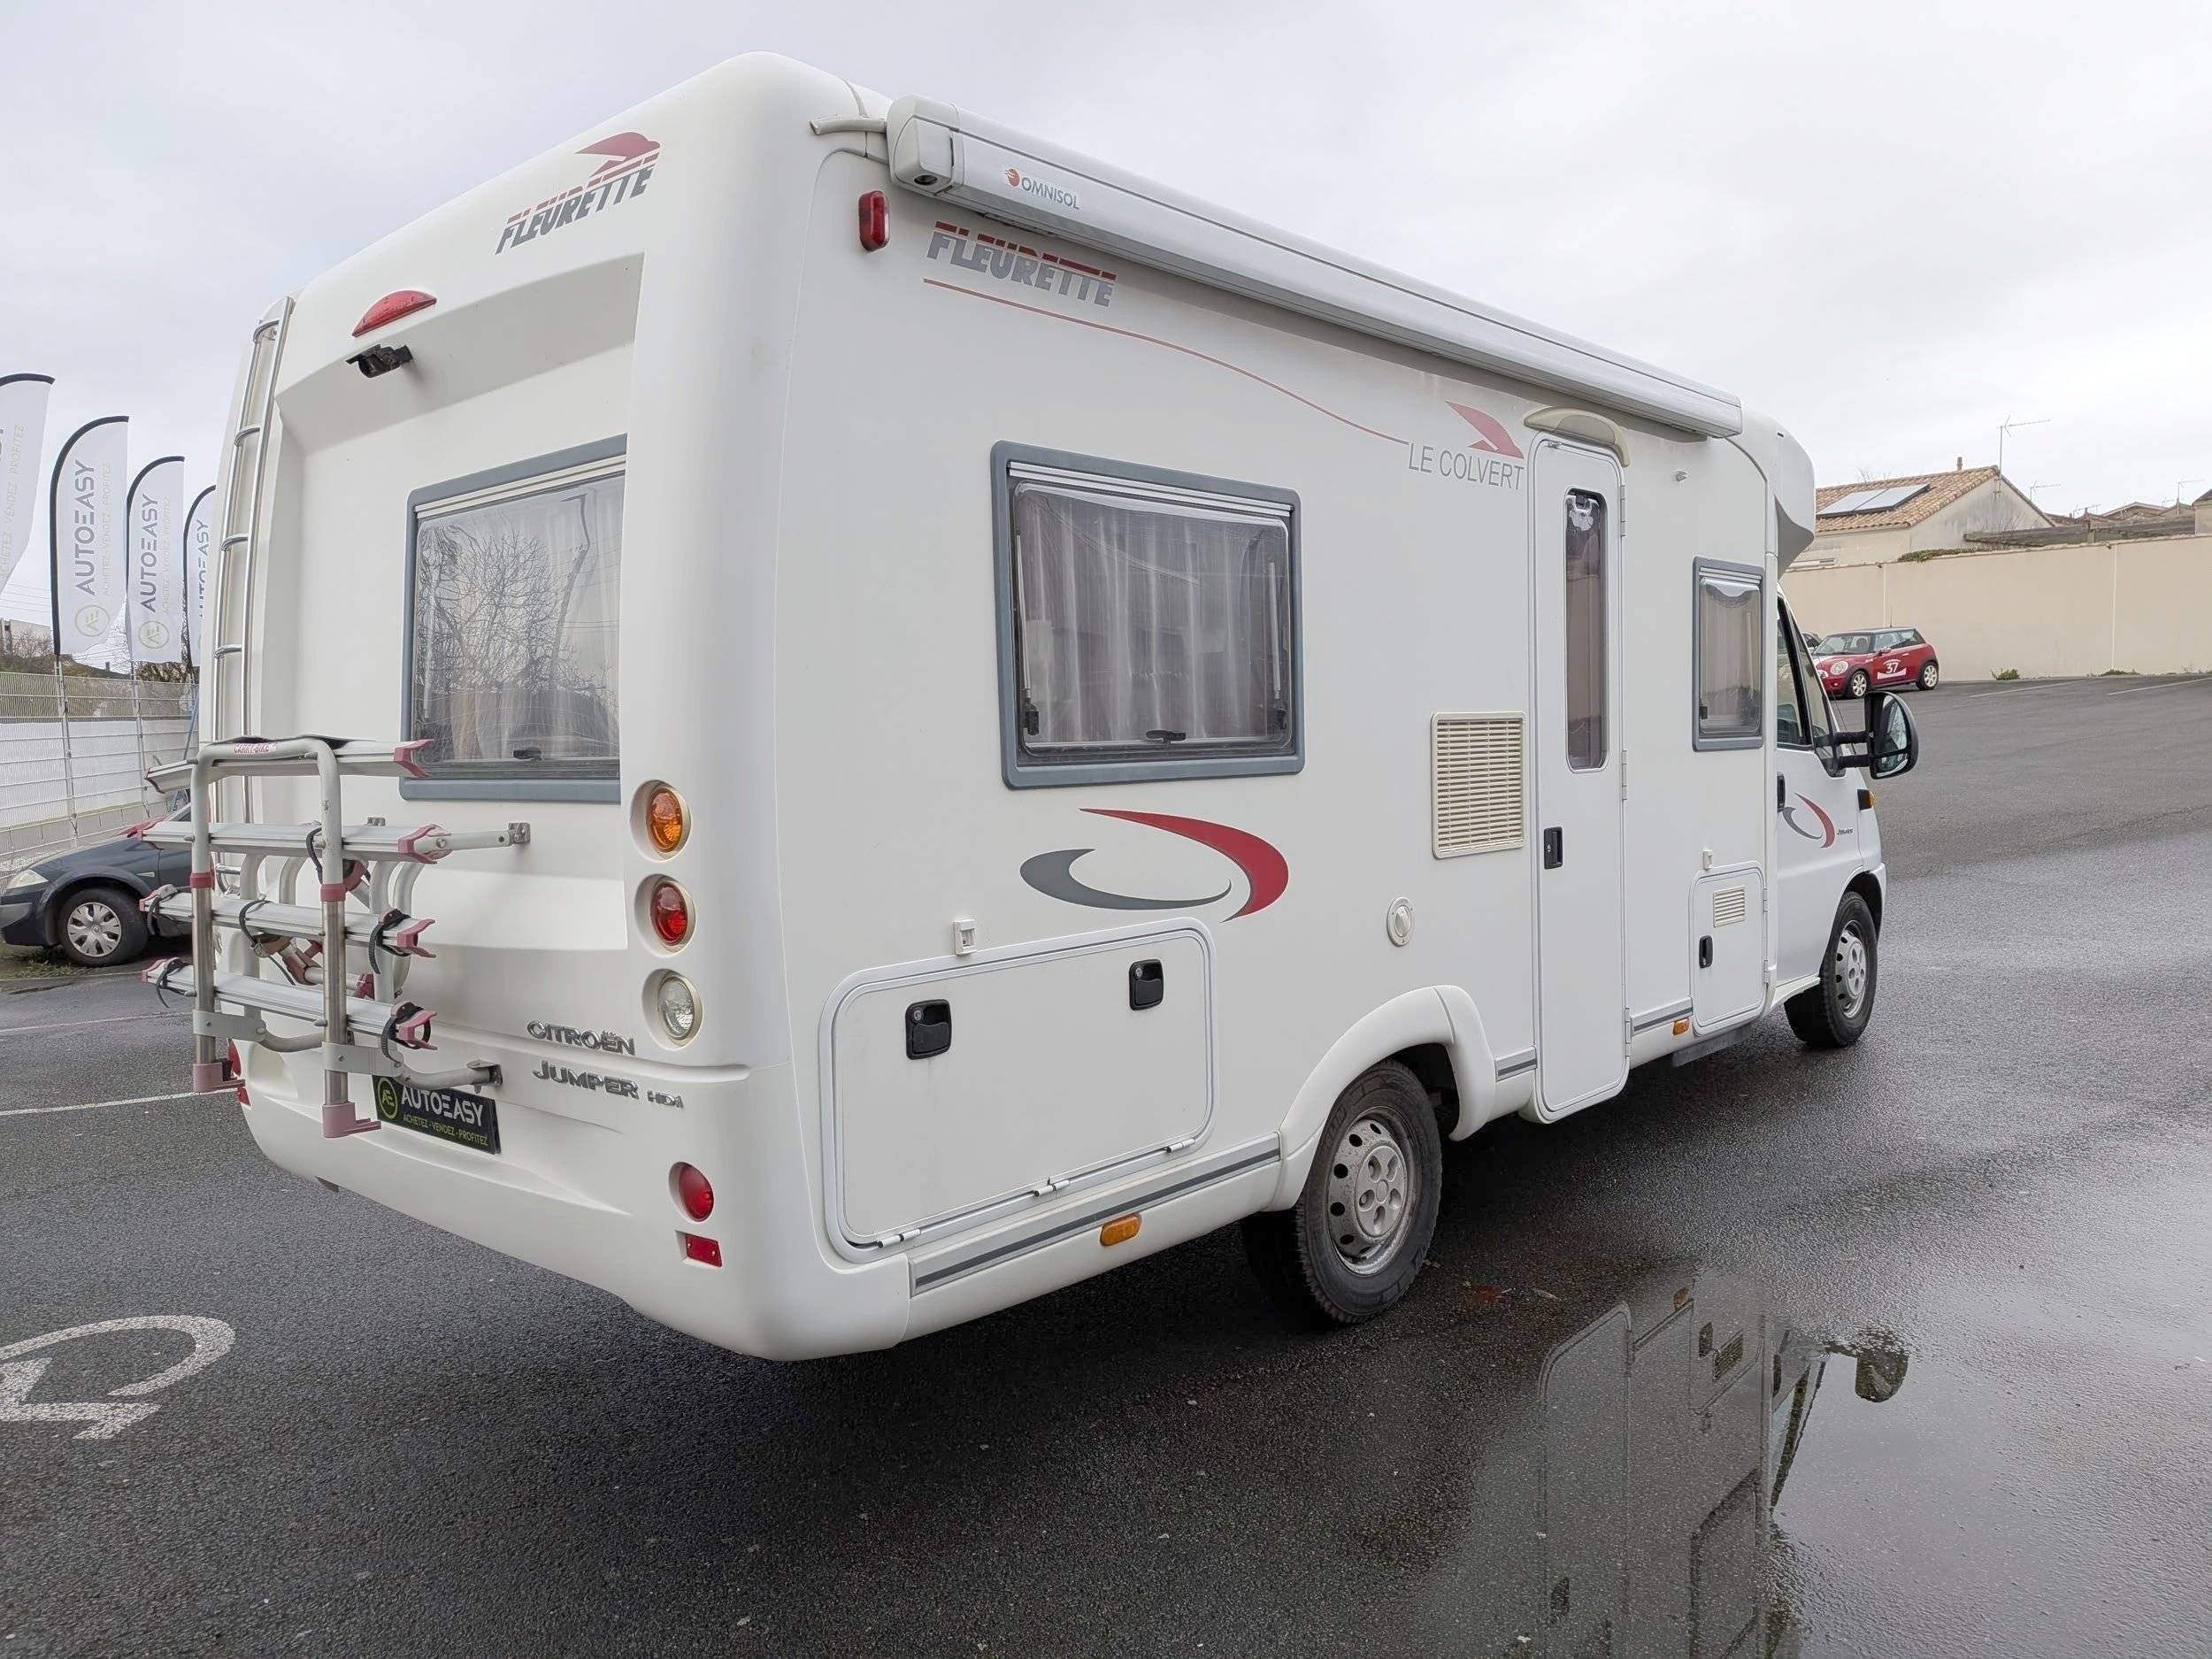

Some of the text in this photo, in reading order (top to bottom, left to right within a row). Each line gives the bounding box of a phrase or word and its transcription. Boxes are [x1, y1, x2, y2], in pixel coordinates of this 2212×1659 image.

[495, 151, 660, 256] FLEURETTE
[1021, 176, 1079, 210] OMNISOL
[926, 220, 1117, 307] FLEURETTE
[1409, 442, 1525, 490] LE COLVERT
[74, 459, 96, 596] AUTOEASY
[140, 494, 158, 613] AUTOEASY
[1886, 662, 1898, 673] 37
[526, 1019, 635, 1056] CITROËN
[532, 1060, 640, 1100] JUMPER
[401, 1084, 483, 1127] AUTOEASY
[403, 1113, 428, 1129] ACHETEZ
[432, 1120, 455, 1138] VENDEZ
[458, 1128, 488, 1147] PROFITEZ
